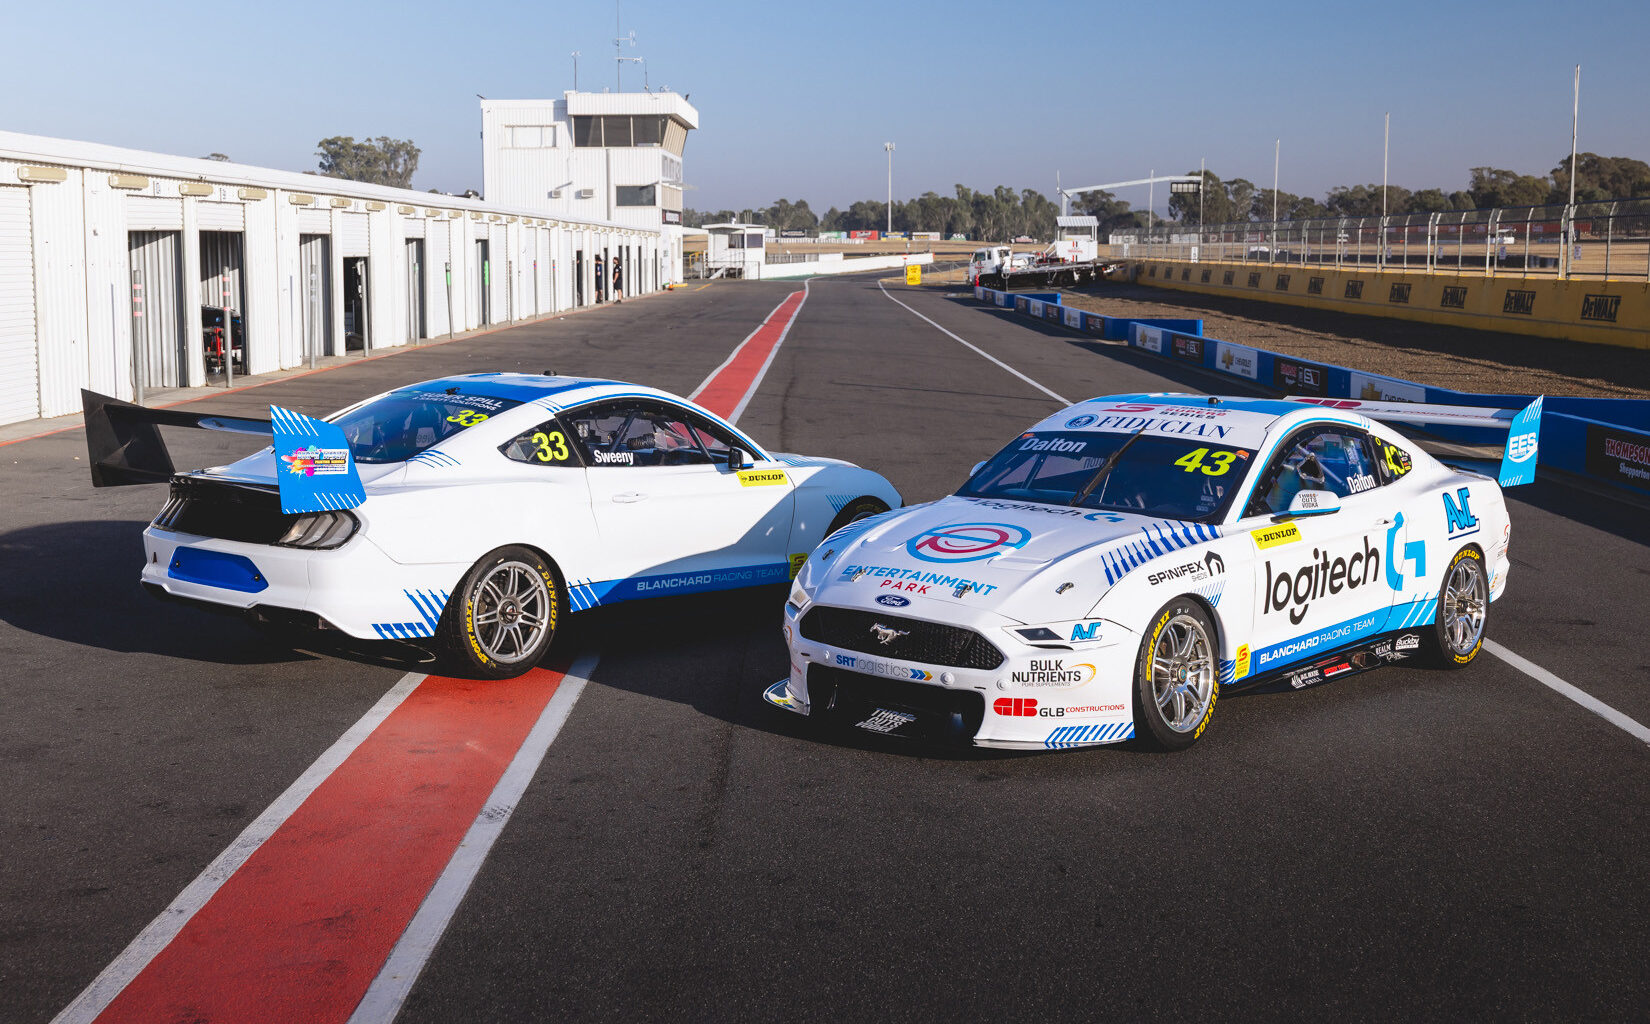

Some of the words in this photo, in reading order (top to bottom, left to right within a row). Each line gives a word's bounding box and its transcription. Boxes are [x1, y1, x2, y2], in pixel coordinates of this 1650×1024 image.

[447, 410, 489, 427] 33
[1095, 416, 1234, 439] FIDUCIAN
[531, 431, 569, 462] 33
[1018, 438, 1088, 453] Dalton
[1509, 432, 1537, 455] EES
[593, 449, 634, 465] Sweeny
[1174, 448, 1237, 477] 43
[1347, 473, 1376, 494] Dalton
[1263, 527, 1297, 542] DUNLOP
[1453, 549, 1480, 567] DUNLOP
[636, 575, 712, 591] BLANCHARD
[713, 570, 753, 583] RACING
[756, 568, 784, 578] TEAM
[841, 565, 998, 596] ENTERTAINMENT
[880, 579, 932, 595] PARK
[1263, 535, 1380, 626] logitech
[541, 570, 557, 630] DUNLOP
[1153, 610, 1170, 641] MAXX
[1259, 635, 1320, 664] BLANCHARD
[1320, 625, 1351, 643] RACING
[1353, 617, 1375, 632] TEAM
[1012, 671, 1081, 683] NUTRIENTS
[1030, 659, 1063, 672] BULK
[1039, 707, 1065, 718] GLB
[1066, 704, 1126, 714] CONSTRUCTIONS
[1193, 680, 1220, 740] DUNLOP
